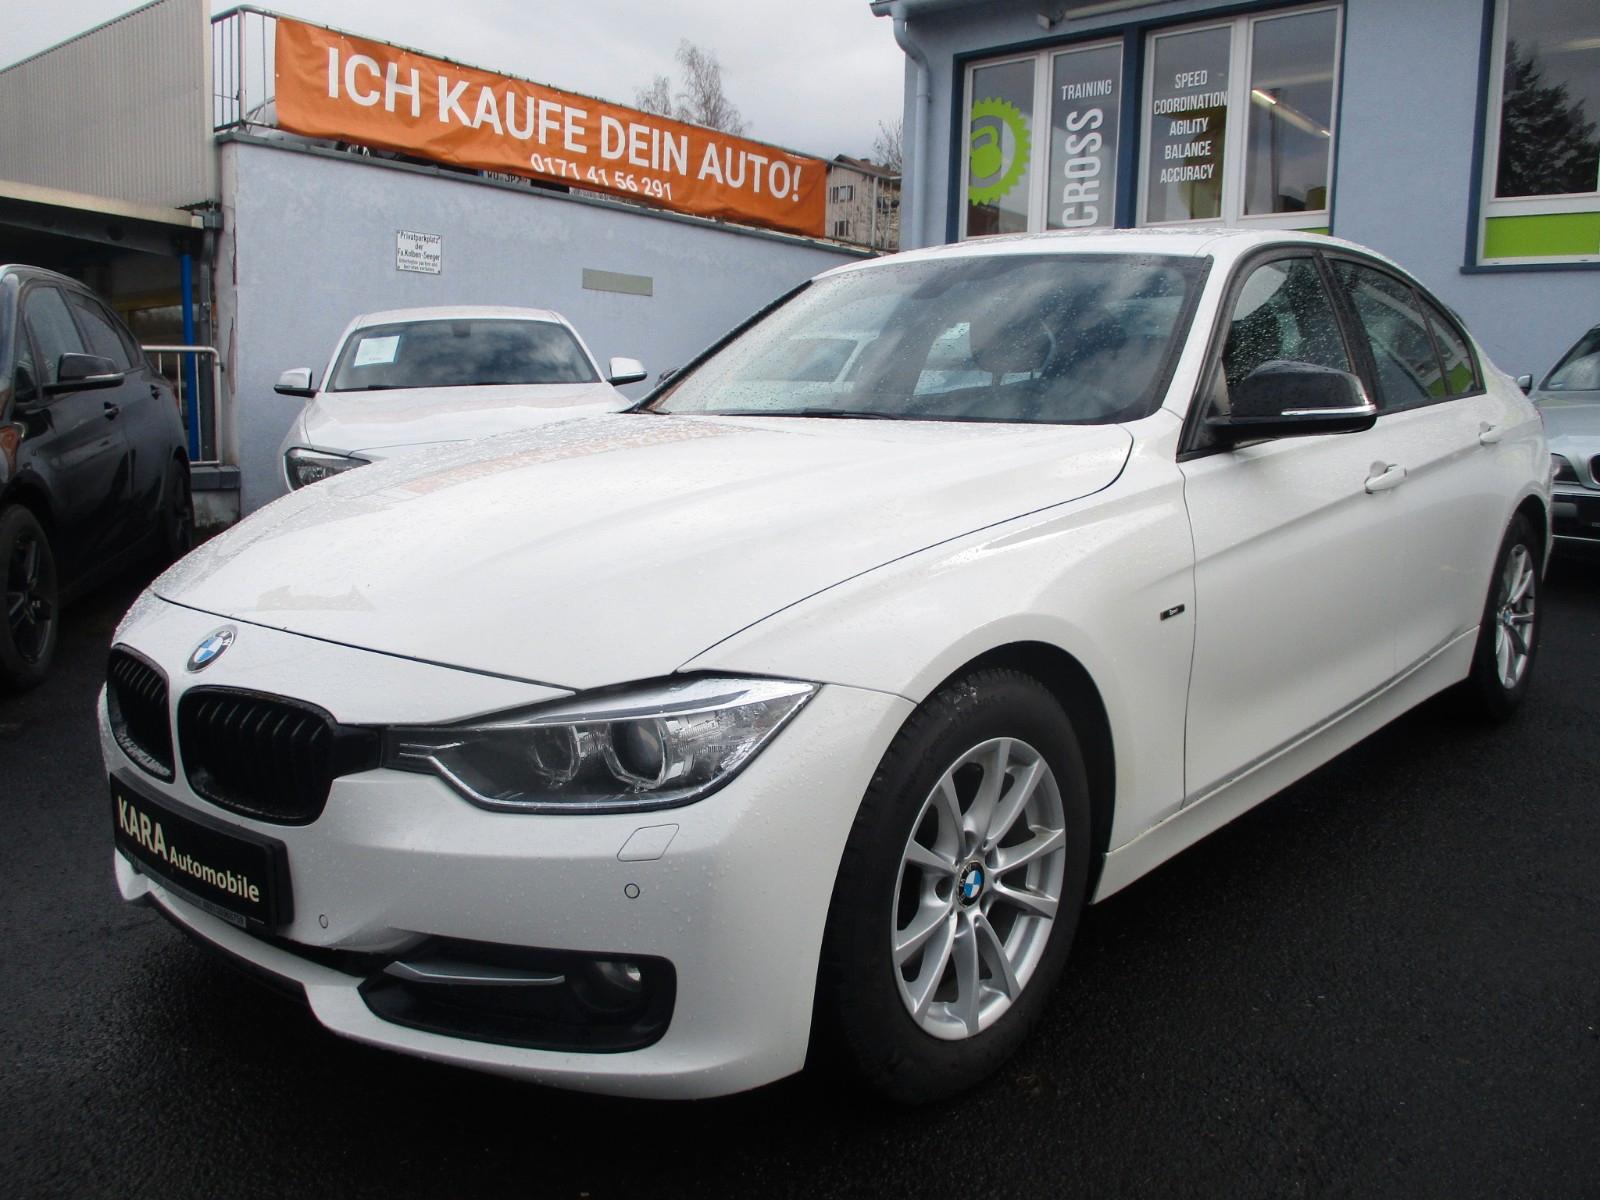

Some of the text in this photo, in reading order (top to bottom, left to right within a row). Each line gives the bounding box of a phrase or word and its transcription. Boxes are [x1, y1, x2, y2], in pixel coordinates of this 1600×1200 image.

[1061, 79, 1113, 101] TRAINING
[1175, 70, 1208, 89] SPEED
[1153, 91, 1228, 115] COORDINATION
[328, 46, 801, 202] ICH KAUFE DEIN AUTO!
[1169, 117, 1209, 136] AGILITY
[1164, 140, 1211, 160] BALANCE
[530, 153, 580, 181] 0171
[586, 166, 609, 187] 41
[614, 171, 639, 193] 56
[641, 177, 672, 201] 291
[1061, 108, 1103, 229] CROSS
[1160, 163, 1214, 184] ACCURACY
[118, 795, 168, 861] KARA
[170, 846, 260, 903] Automobile
